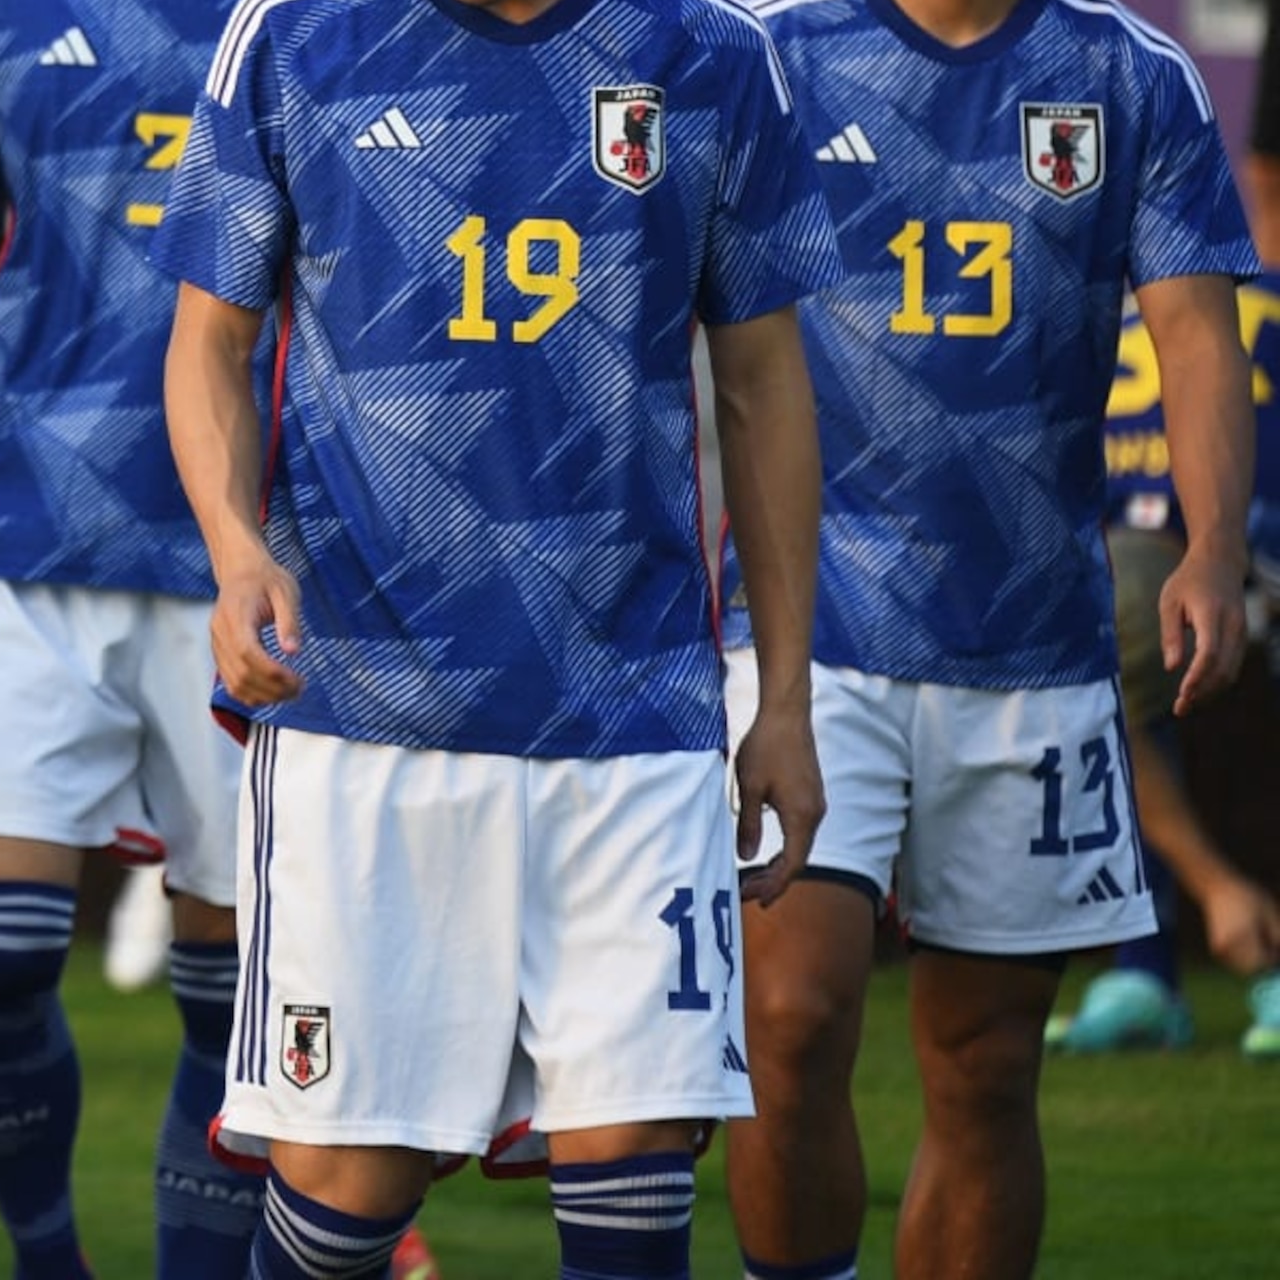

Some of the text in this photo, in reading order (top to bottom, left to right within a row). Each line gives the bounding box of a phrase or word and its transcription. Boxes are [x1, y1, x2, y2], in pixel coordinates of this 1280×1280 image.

[615, 88, 657, 101] JAPAN
[1041, 107, 1083, 118] JAPAN
[448, 215, 581, 343] 19
[888, 220, 1013, 337] 13
[1029, 735, 1121, 856] 13
[157, 1171, 266, 1207] JAPA
